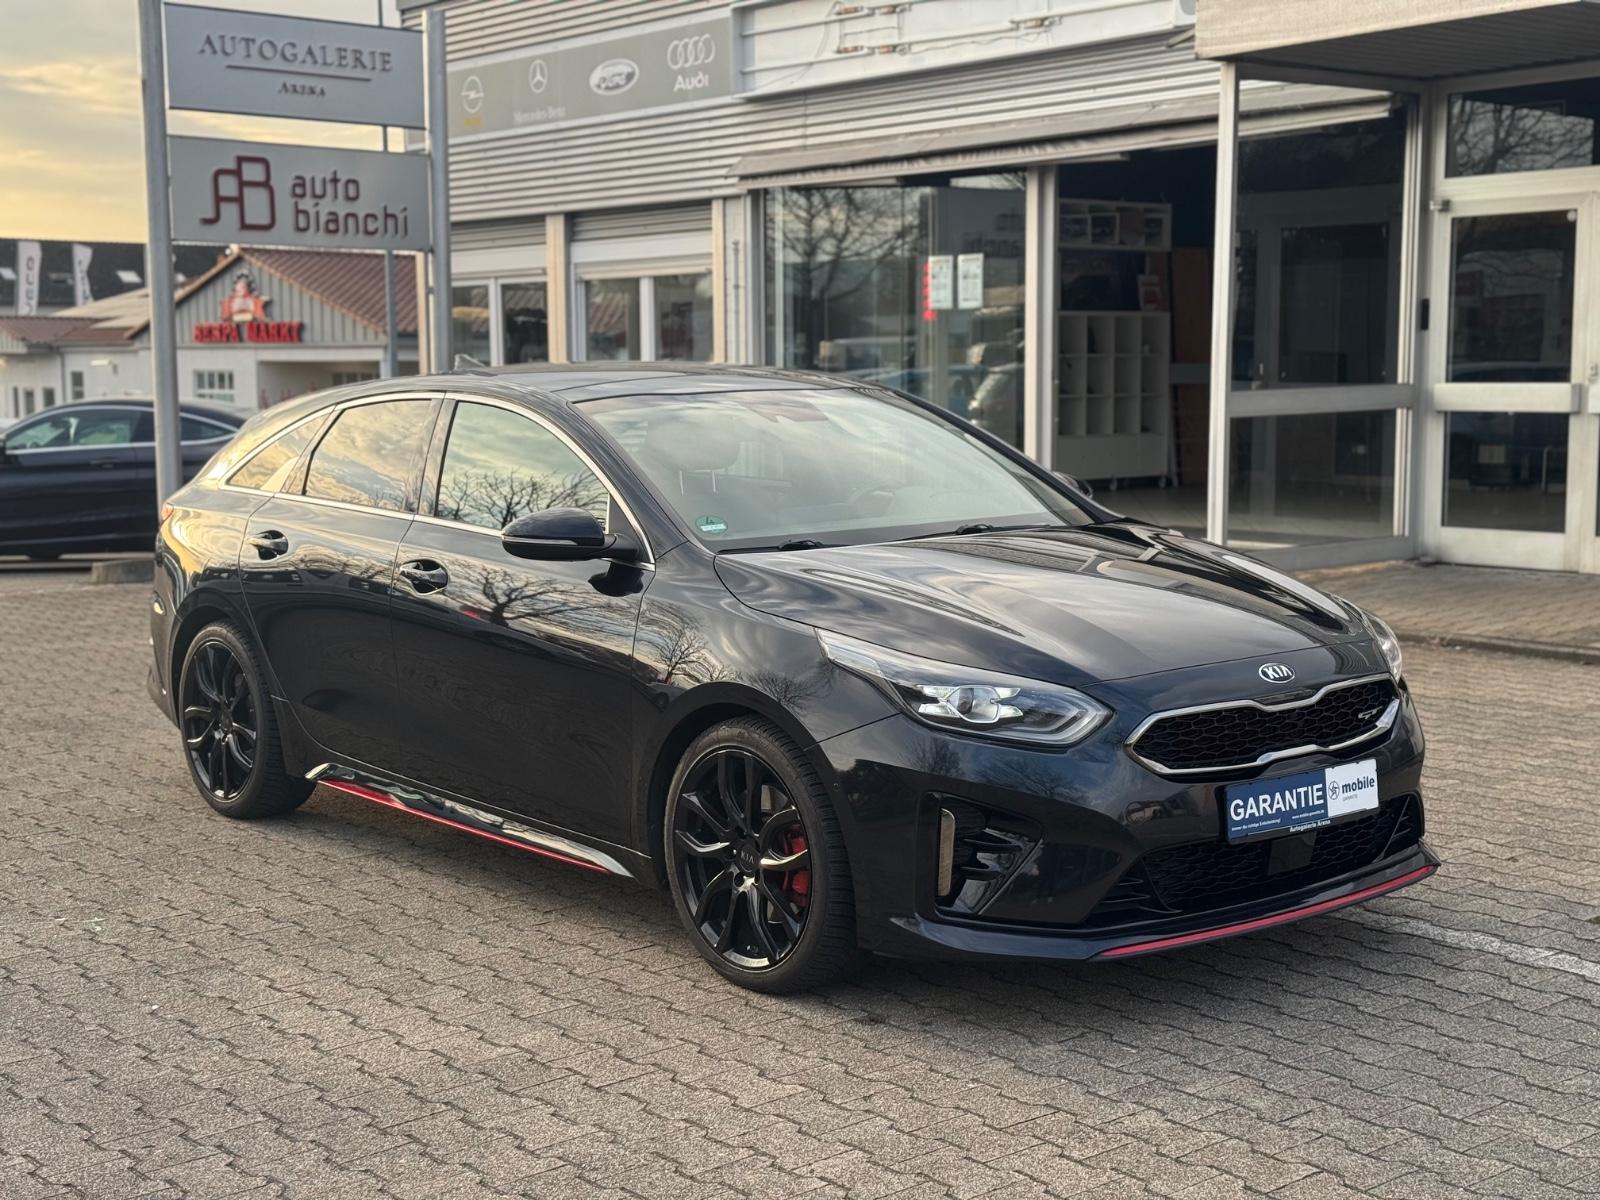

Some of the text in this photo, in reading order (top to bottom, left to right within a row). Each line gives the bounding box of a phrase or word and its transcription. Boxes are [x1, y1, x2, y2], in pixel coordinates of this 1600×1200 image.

[198, 34, 394, 73] AUTOGALERIE
[673, 71, 710, 91] Audi
[291, 170, 361, 203] auto
[294, 201, 408, 237] bianchi
[1263, 665, 1293, 679] KIA
[1341, 775, 1375, 794] mobile
[1230, 783, 1324, 821] GARANTIE
